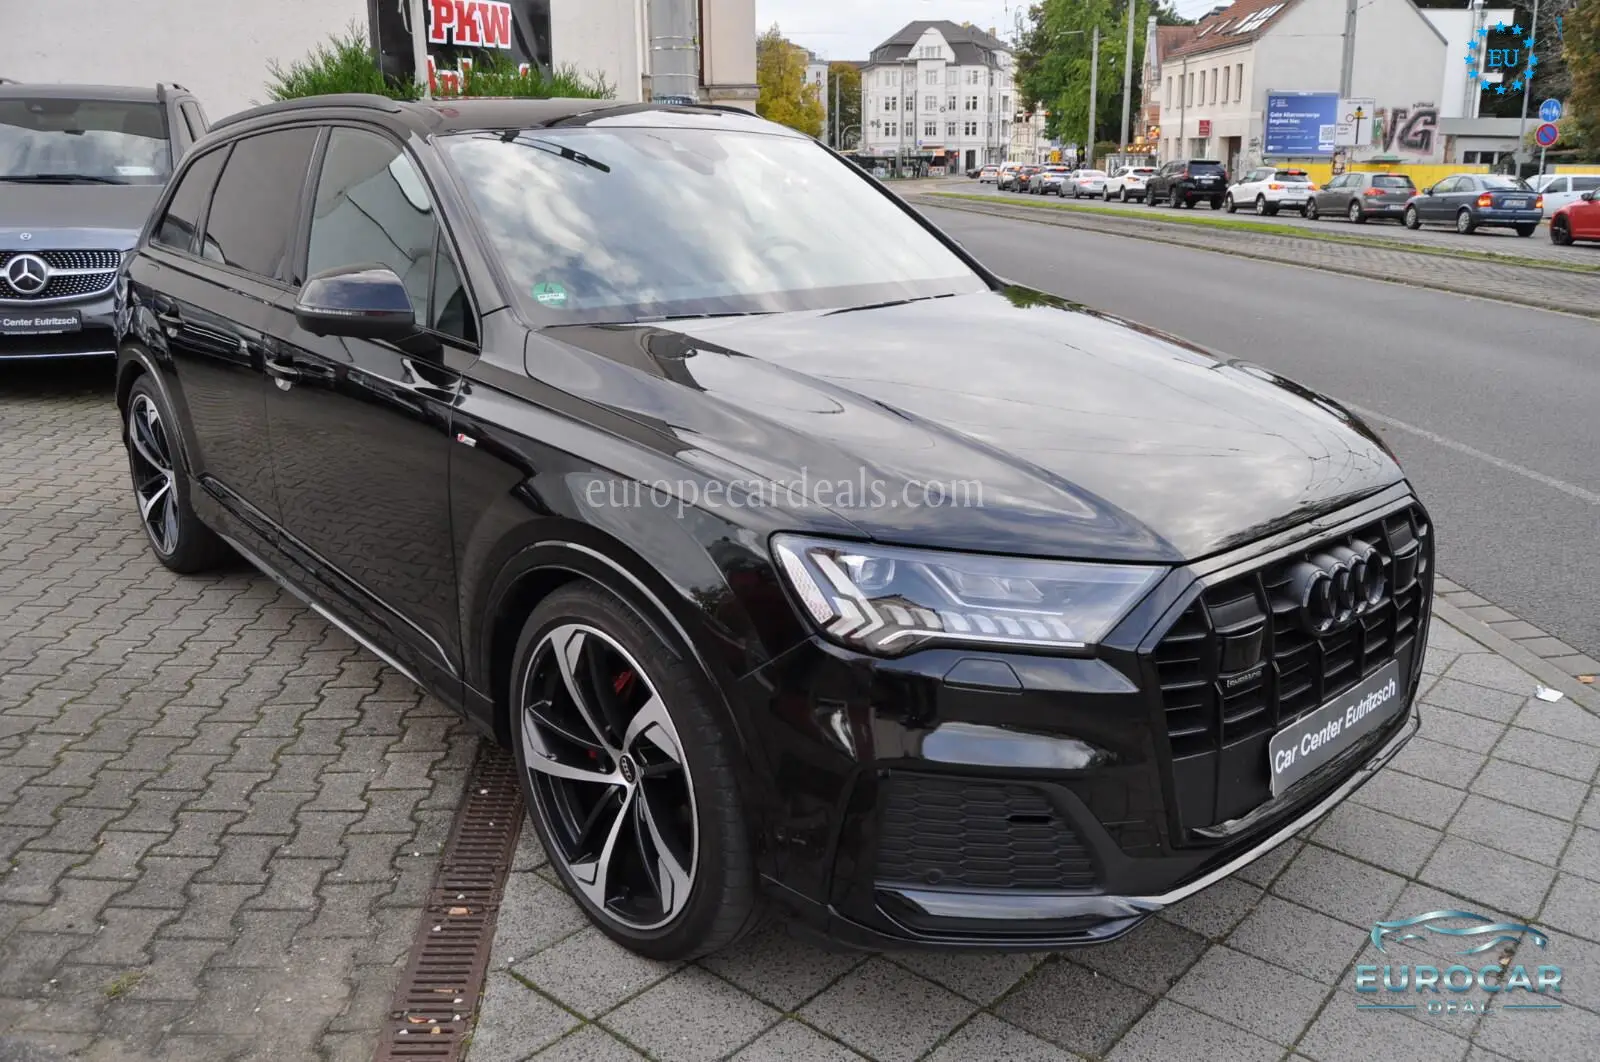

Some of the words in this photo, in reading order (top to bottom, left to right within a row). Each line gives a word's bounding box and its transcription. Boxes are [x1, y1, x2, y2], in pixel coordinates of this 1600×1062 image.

[428, 0, 511, 49] PKW
[3, 318, 32, 327] Center
[34, 316, 78, 326] Eutritzsch
[1274, 745, 1299, 774] Car
[1300, 717, 1344, 757] Center
[1345, 678, 1397, 729] Eutritzsch
